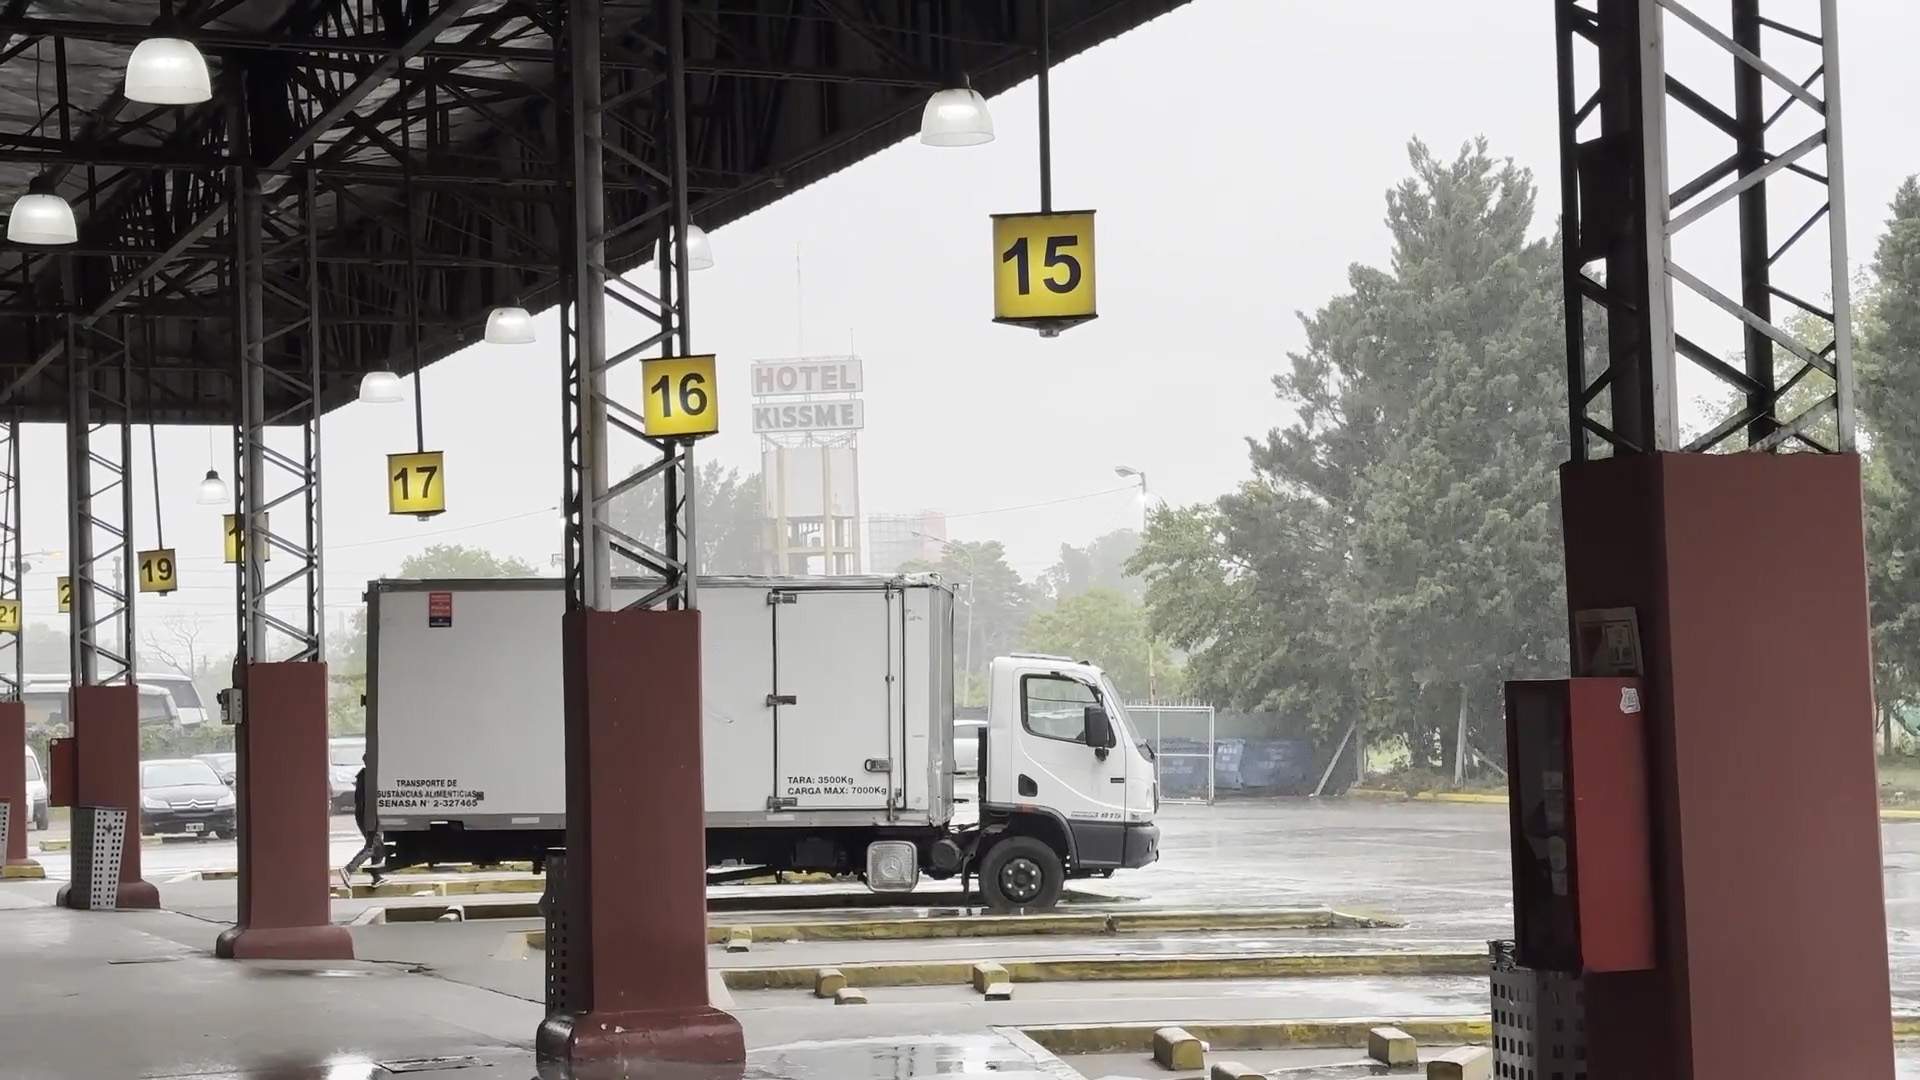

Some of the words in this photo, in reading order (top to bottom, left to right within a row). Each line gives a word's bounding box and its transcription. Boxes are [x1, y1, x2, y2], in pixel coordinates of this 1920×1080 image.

[1002, 235, 1082, 295] 15
[755, 365, 856, 393] HOTEL
[651, 373, 708, 417] 16
[394, 466, 437, 500] 17
[142, 558, 172, 582] 19
[0, 606, 17, 624] 21
[396, 779, 445, 787] TRANSPORTE
[447, 779, 457, 787] DE
[787, 776, 815, 785] TARA:
[817, 776, 854, 785] 3500Kg
[376, 790, 423, 799] SUSTANCIAS
[425, 790, 478, 798] ALIMENTICIAS
[787, 787, 821, 795] CARGA
[824, 787, 848, 795] MAX:
[851, 786, 887, 795] 7000Kg
[378, 799, 417, 808] SENASA
